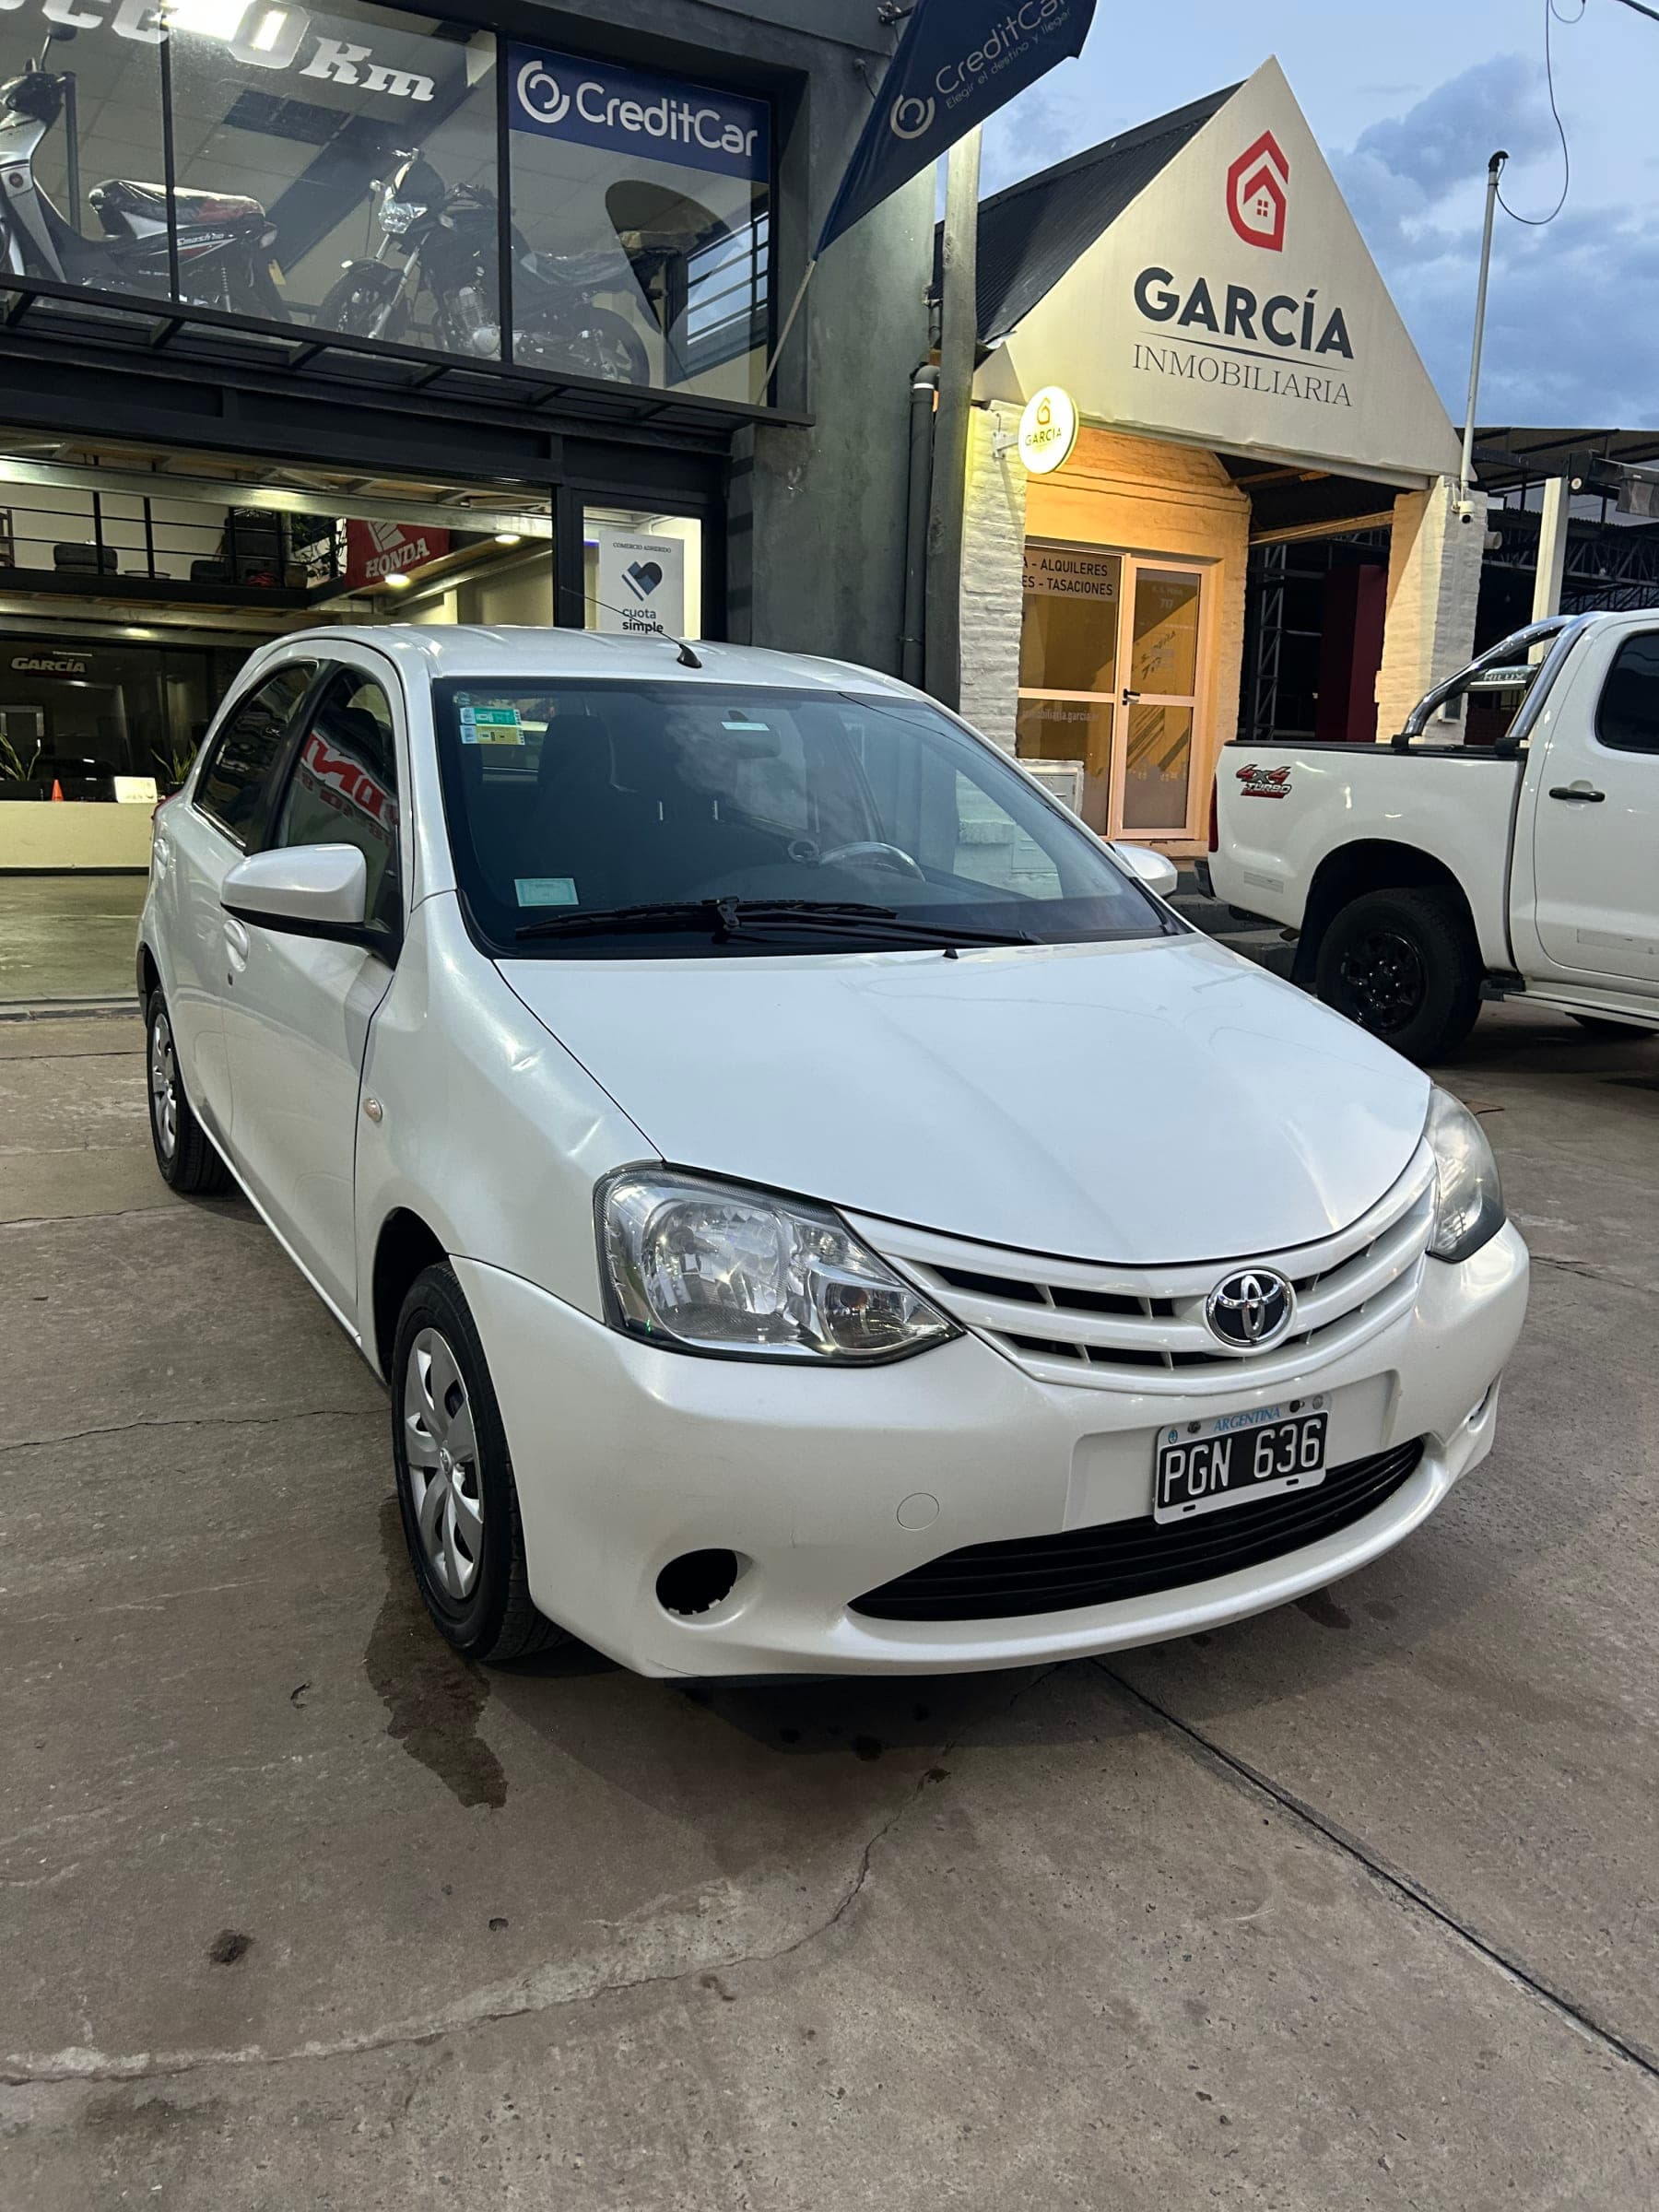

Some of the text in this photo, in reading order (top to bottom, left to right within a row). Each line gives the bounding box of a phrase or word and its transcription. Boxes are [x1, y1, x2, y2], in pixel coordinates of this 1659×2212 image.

[936, 0, 1065, 94] CreditCa
[946, 83, 974, 109] Elegir
[978, 71, 989, 84] el
[991, 42, 1029, 74] destino
[1041, 7, 1071, 35] llegar
[576, 81, 758, 156] CreditCar
[1135, 266, 1354, 359] GARCÍA
[1132, 344, 1353, 406] INMOBILIARIA
[365, 537, 430, 579] HONDA
[1041, 559, 1108, 577] ALQUILERES
[1047, 578, 1113, 595] TASACIONES
[622, 608, 656, 619] cuota
[622, 619, 664, 634] simple
[1484, 673, 1524, 681] HILUX
[1245, 782, 1291, 794] TURBO
[1213, 1406, 1280, 1432] ARGENTINA
[1164, 1418, 1321, 1502] PGN 636
